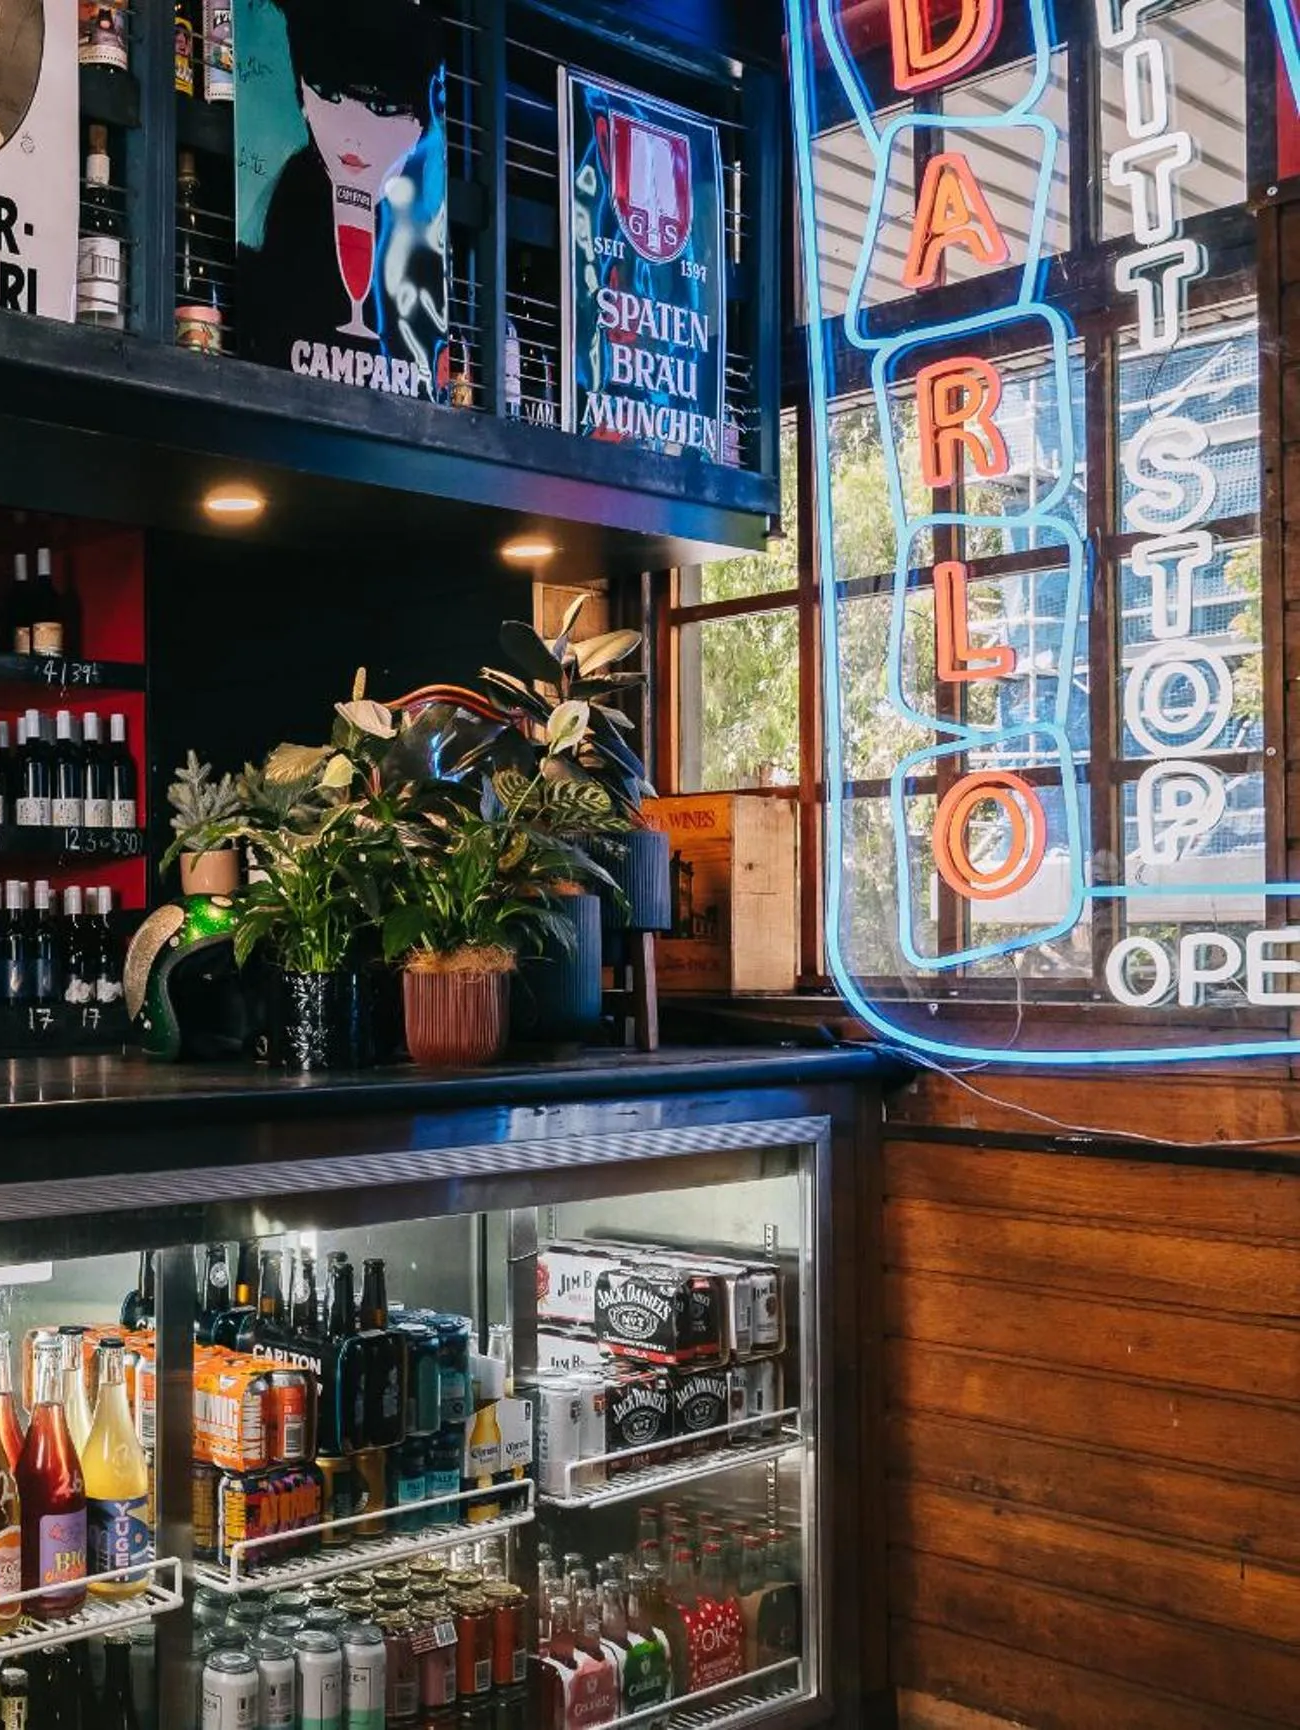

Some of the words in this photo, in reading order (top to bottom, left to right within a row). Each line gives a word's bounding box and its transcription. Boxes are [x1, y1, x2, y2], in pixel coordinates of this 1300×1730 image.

[593, 236, 627, 260] SEIT
[596, 287, 709, 353] SPATEN
[290, 339, 420, 399] CAMPARI
[610, 341, 698, 401] BRÄU
[581, 392, 719, 453] MÜNCHEN
[1123, 415, 1233, 866] STOP
[668, 809, 716, 829] WINES
[65, 827, 80, 851] 12
[28, 1007, 54, 1031] 17
[81, 1007, 102, 1030] 17
[557, 1273, 581, 1298] JIM
[596, 1287, 627, 1311] JACK
[625, 1283, 673, 1320] DANIEL'S
[252, 1344, 322, 1377] CARLTON
